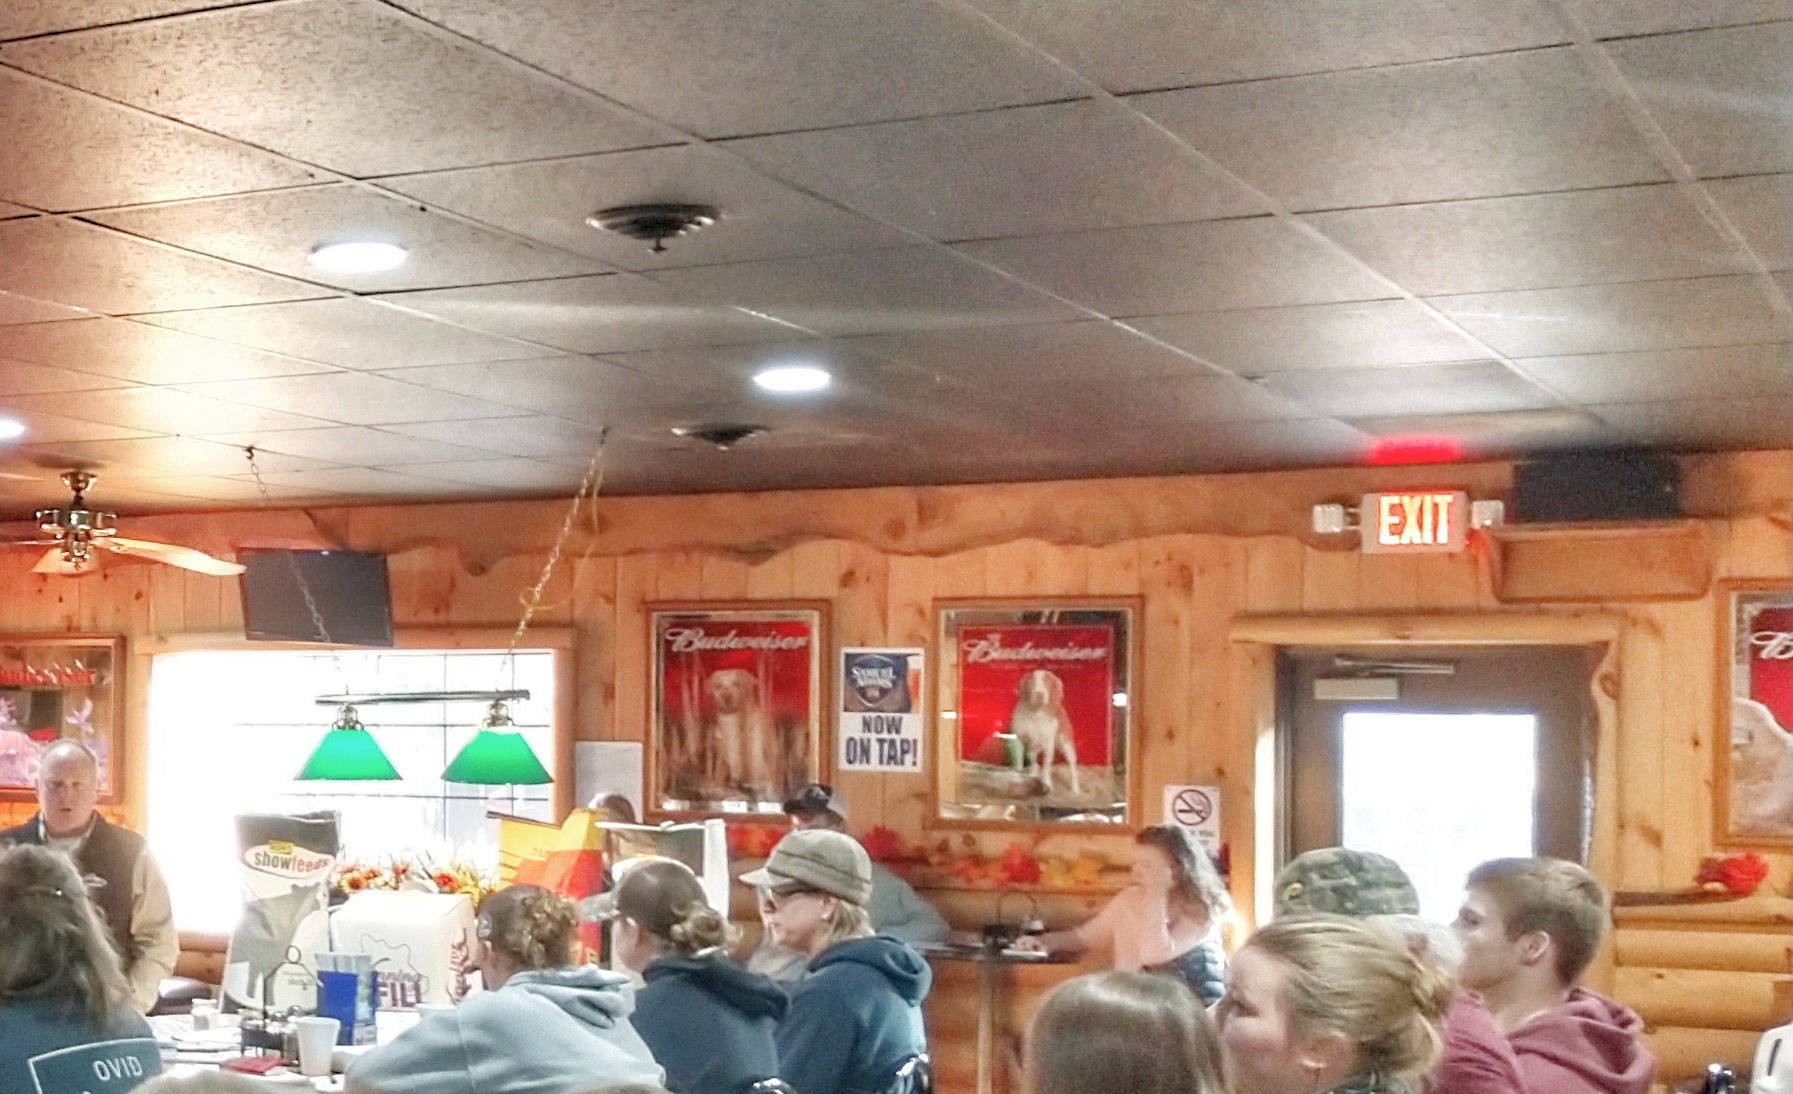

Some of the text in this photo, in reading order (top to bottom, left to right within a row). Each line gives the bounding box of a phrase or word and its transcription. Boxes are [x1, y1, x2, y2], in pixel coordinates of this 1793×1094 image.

[1379, 493, 1454, 545] EXIT
[665, 627, 810, 652] Budweiser
[963, 637, 1107, 663] Budweiser
[862, 715, 903, 735] NOW
[846, 737, 918, 767] ON TAP!
[254, 850, 330, 874] showfeeds
[92, 1055, 143, 1081] OVID
